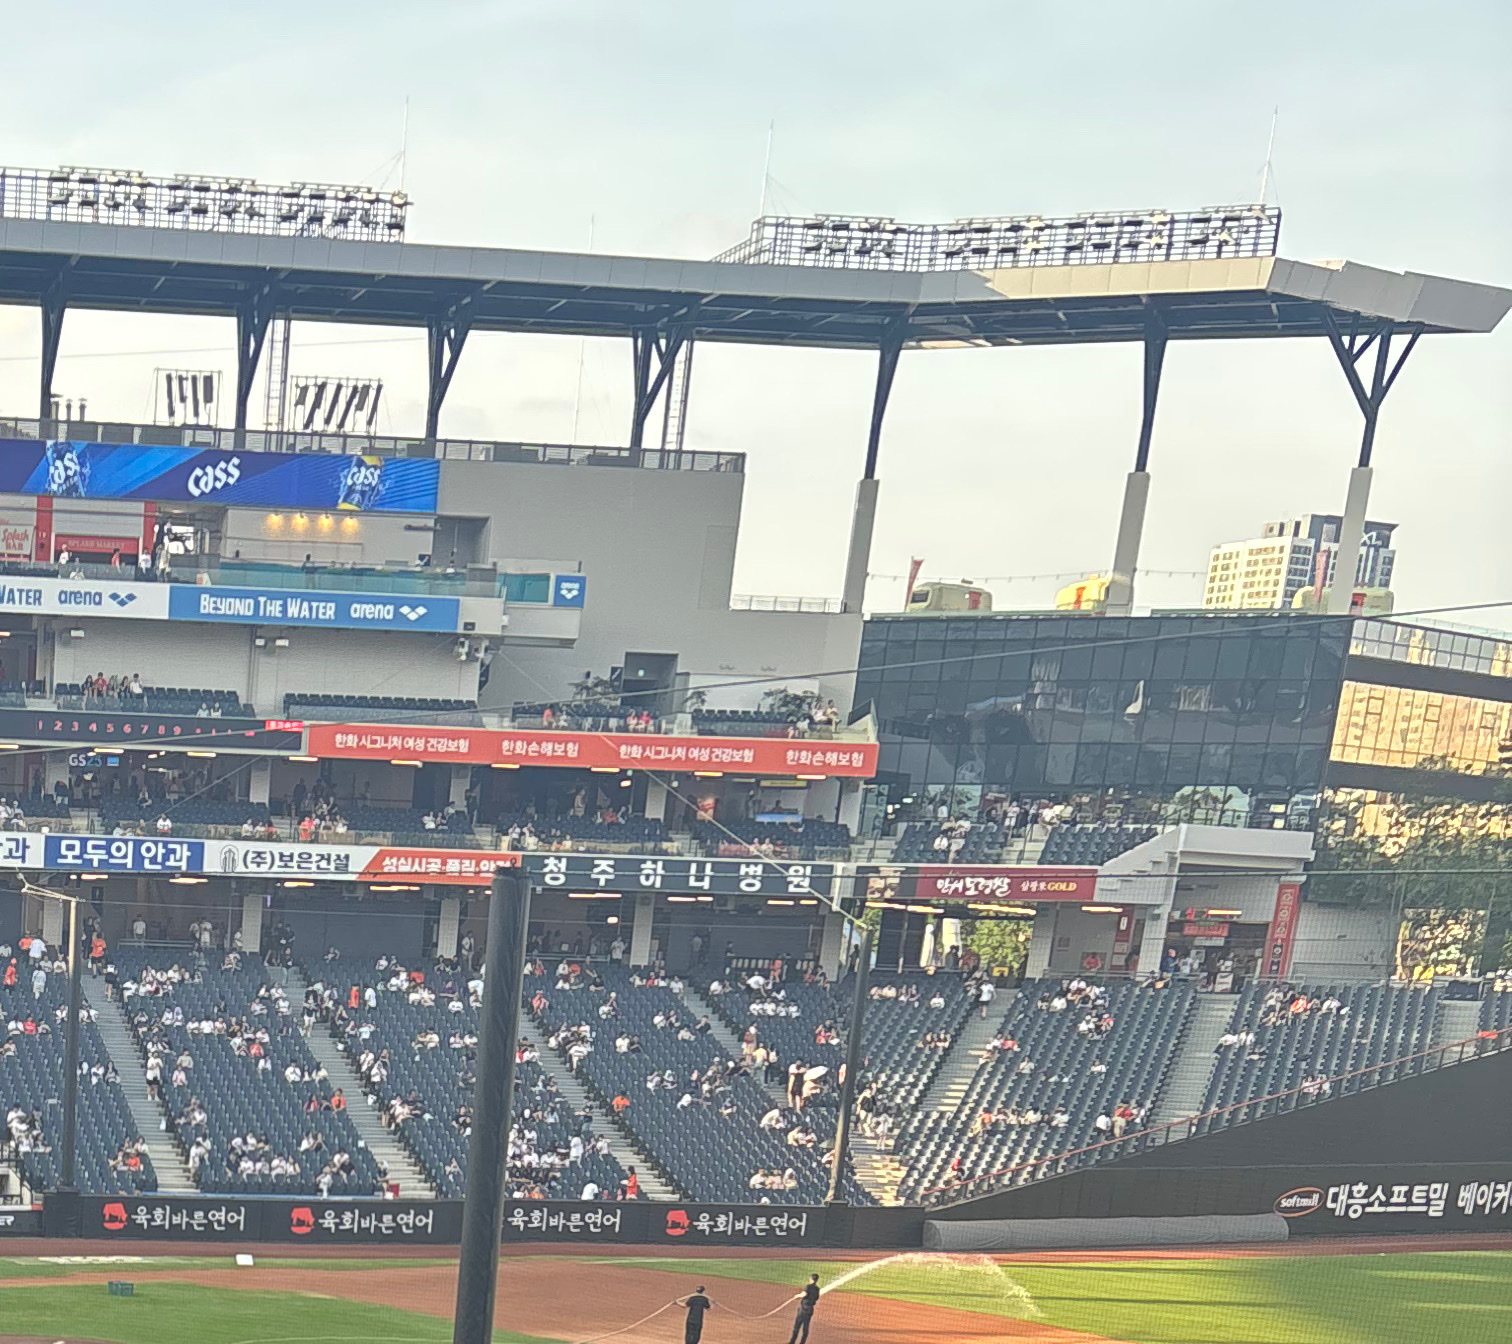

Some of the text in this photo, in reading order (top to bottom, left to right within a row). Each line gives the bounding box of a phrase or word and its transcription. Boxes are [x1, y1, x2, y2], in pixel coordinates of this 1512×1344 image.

[58, 589, 102, 606] arena
[258, 596, 283, 618] THE
[287, 598, 336, 620] WATER
[350, 604, 394, 620] arena
[334, 733, 469, 753] 한화 시그니처 여성 건강보험
[501, 740, 579, 757] 한화손해보험
[619, 744, 754, 763] 한화 시그니처 여성 건강보험
[68, 753, 103, 767] GS25
[786, 750, 864, 768] 한화손해보험
[56, 839, 192, 871] 모두의 안과
[242, 849, 351, 873] (주)보은건설
[1326, 1181, 1512, 1219] 대흥소프트밀 베이커
[131, 1205, 246, 1231] 육회바른연어
[318, 1208, 434, 1234] 육회바른연어
[507, 1207, 622, 1233] 육회바른연어
[692, 1212, 808, 1237] 육회바른연어
